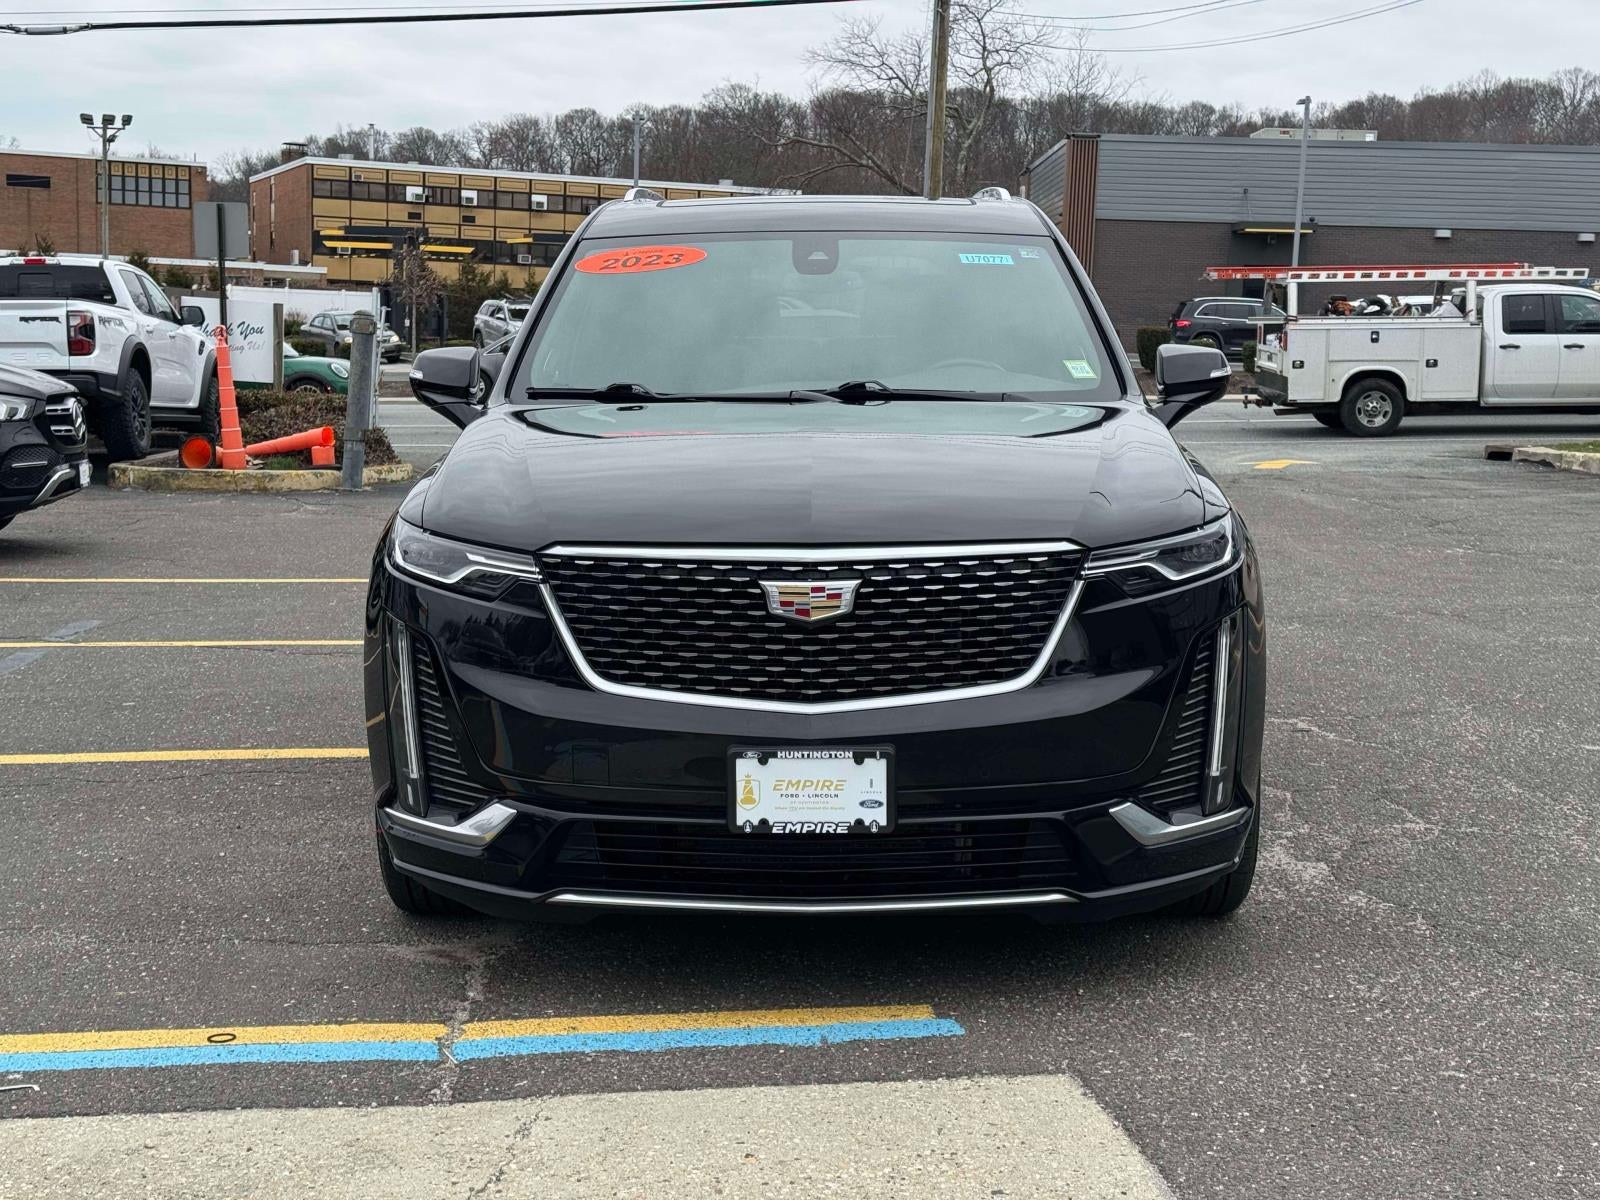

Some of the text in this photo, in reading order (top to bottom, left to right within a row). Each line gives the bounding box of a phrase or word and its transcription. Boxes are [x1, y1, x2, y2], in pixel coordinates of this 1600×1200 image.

[599, 253, 684, 270] 2023
[237, 321, 265, 340] You
[777, 751, 853, 759] HUNTINGTON
[773, 779, 847, 792] EMPIRE
[771, 822, 850, 834] EMPIRE
